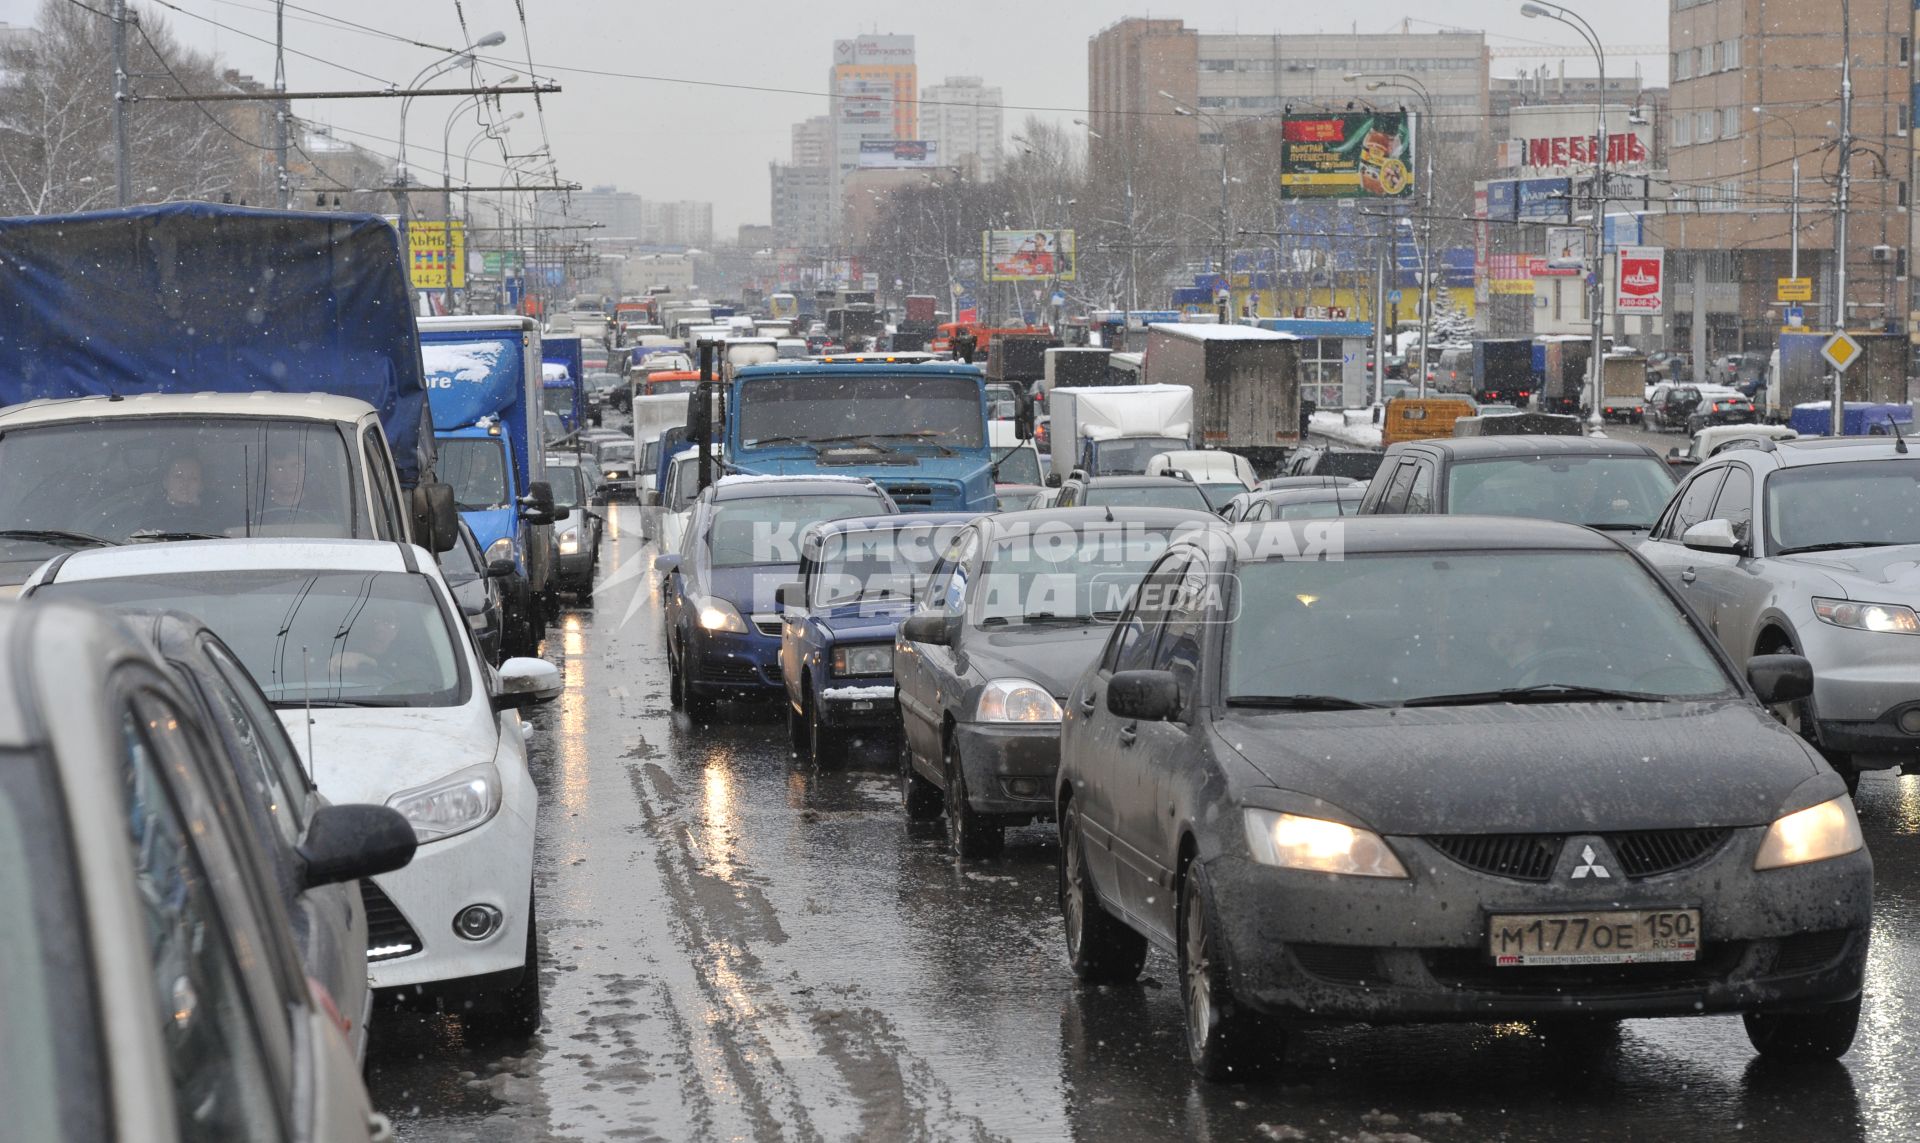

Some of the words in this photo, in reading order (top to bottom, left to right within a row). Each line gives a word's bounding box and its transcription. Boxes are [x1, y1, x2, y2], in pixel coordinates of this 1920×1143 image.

[1530, 133, 1645, 167] МЕБЕЛЬ
[1645, 913, 1692, 938] 150
[1653, 939, 1677, 949] RUS
